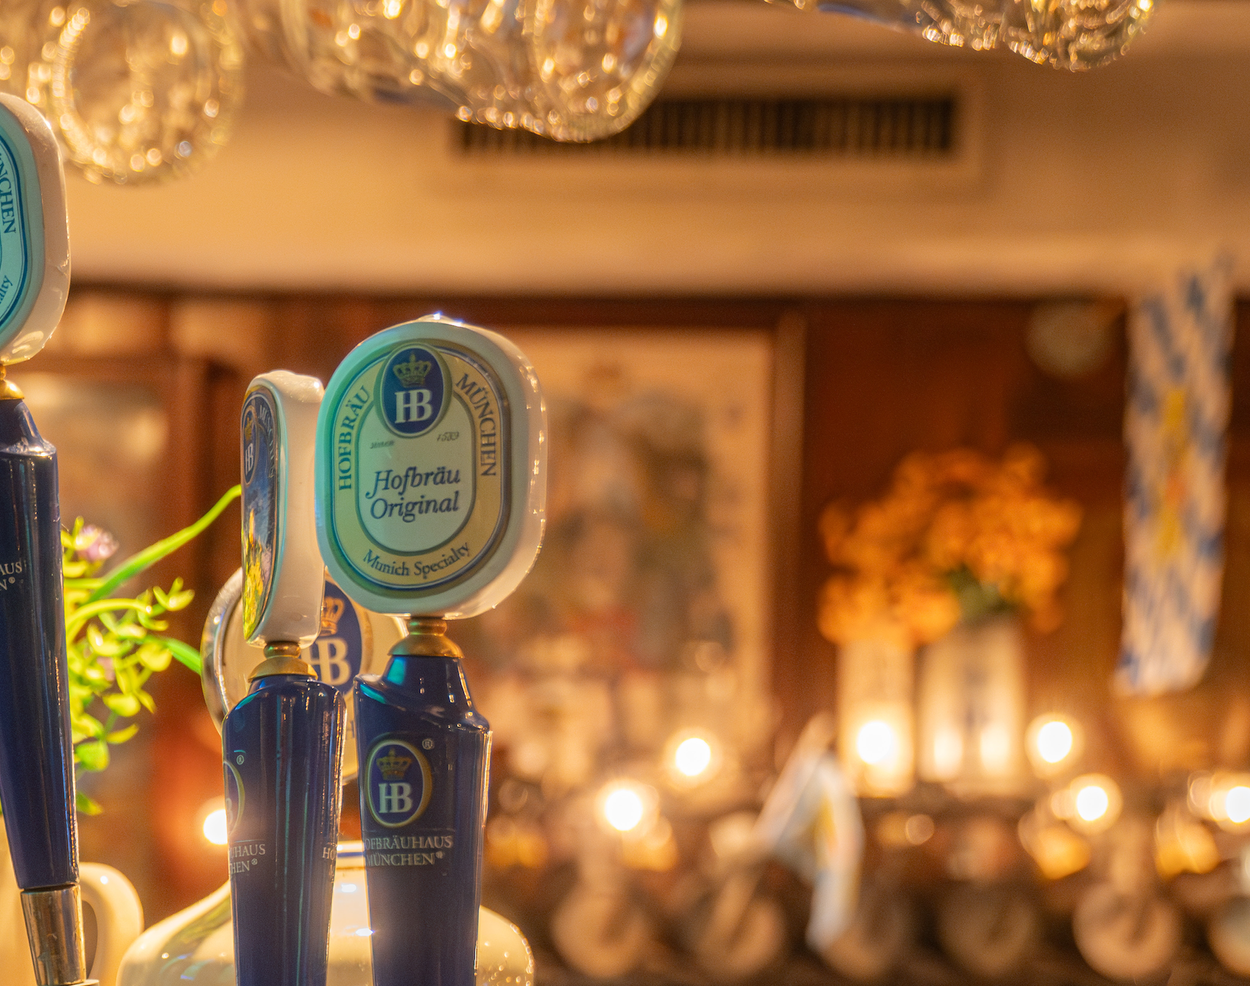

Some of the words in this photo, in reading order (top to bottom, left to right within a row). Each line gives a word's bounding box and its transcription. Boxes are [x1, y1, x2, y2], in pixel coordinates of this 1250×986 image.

[394, 388, 433, 424] HB
[338, 385, 371, 491] HOFBRÄU
[455, 373, 497, 477] MÜNCHEN
[365, 466, 461, 499] Hofbräu
[370, 491, 460, 523] Original
[363, 549, 410, 577] Munich
[414, 542, 471, 580] Specialty
[378, 782, 413, 814] HB
[365, 834, 454, 852] OFBRÄUHAUS
